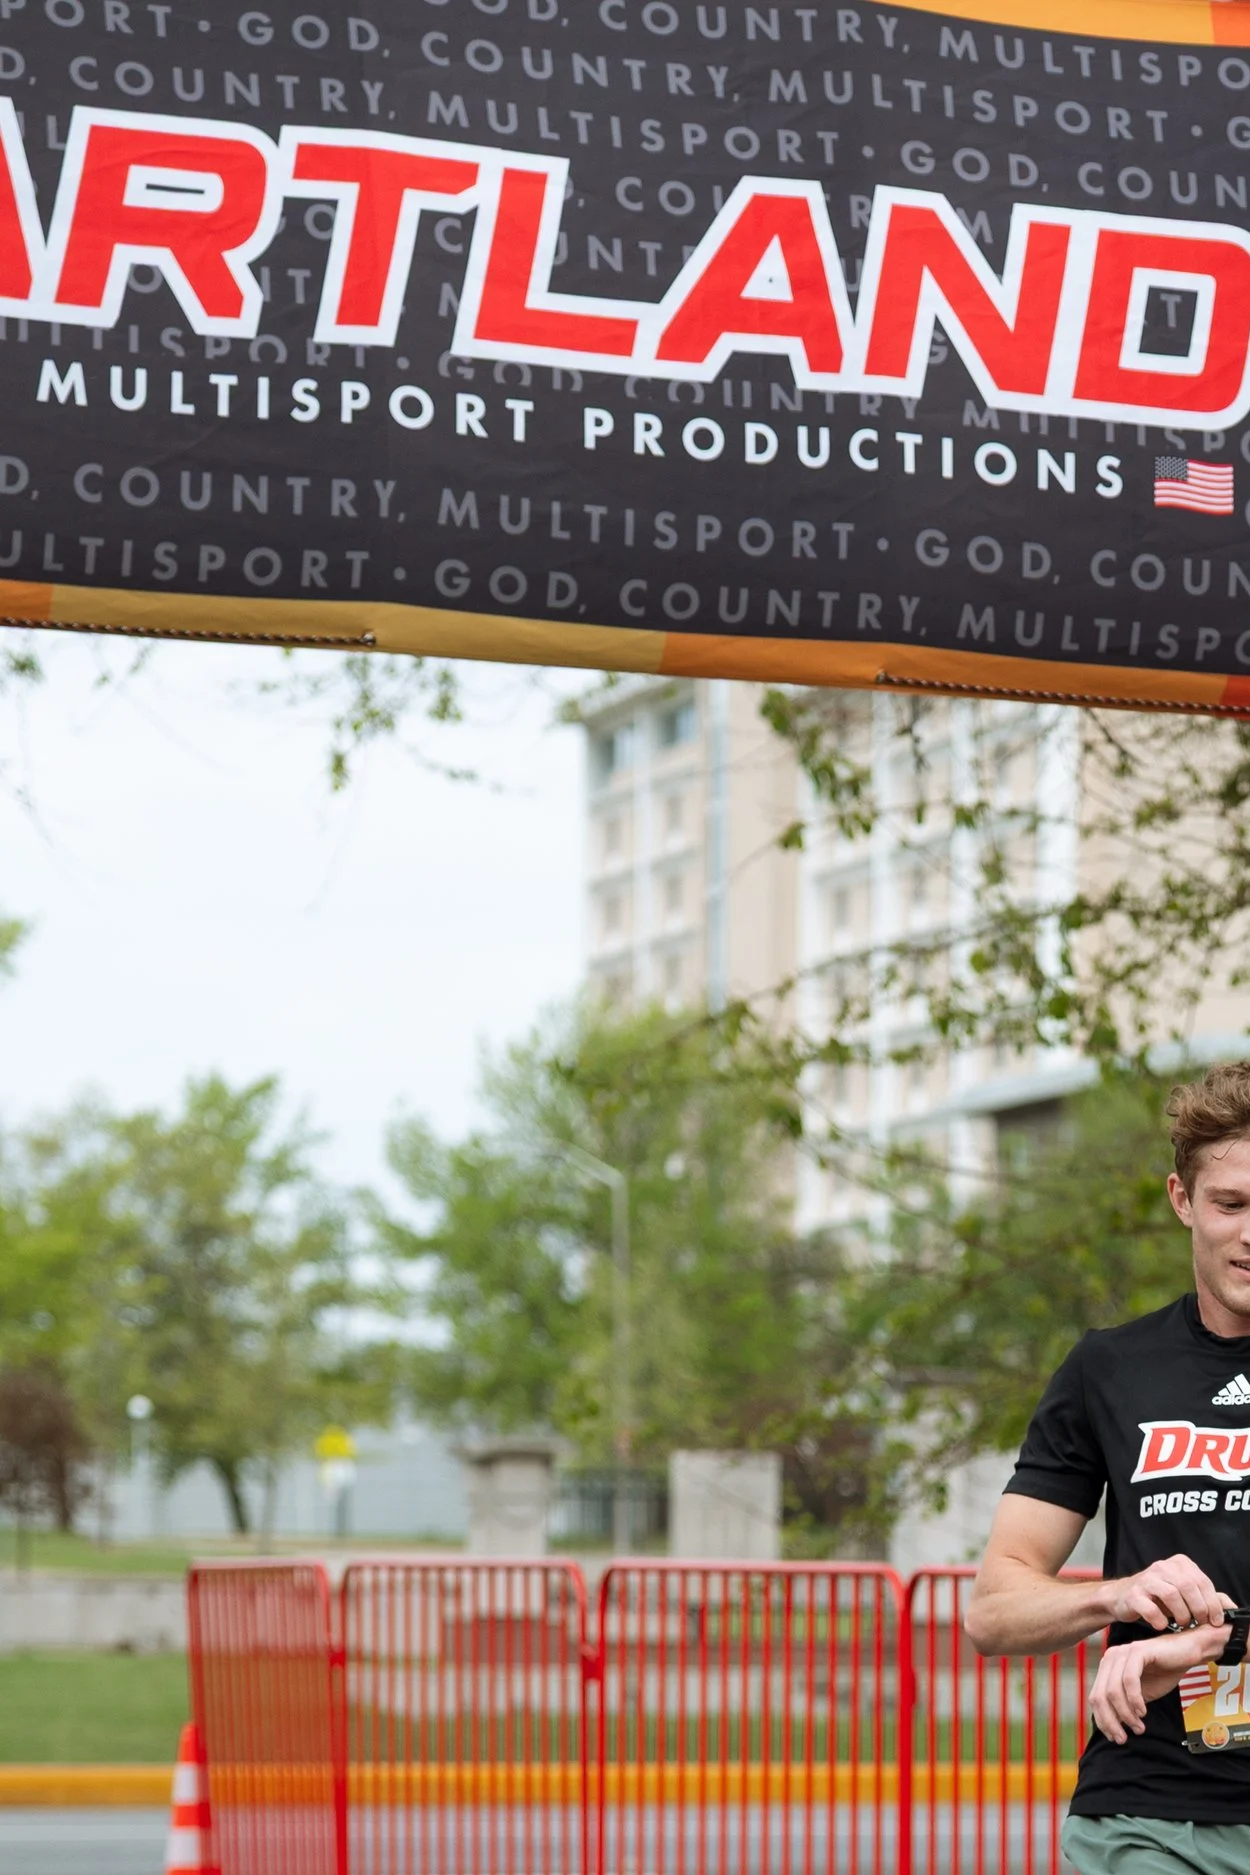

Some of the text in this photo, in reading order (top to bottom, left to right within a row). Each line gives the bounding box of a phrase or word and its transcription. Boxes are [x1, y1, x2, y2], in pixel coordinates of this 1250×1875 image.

[237, 11, 390, 58] GOD,
[420, 31, 740, 103] COUNTRY,
[768, 69, 1168, 142] MULTISPORT
[599, 0, 910, 53] COUNTRY,
[69, 56, 396, 120] COUNTRY,
[427, 91, 839, 164] MULTISPORT
[900, 140, 1049, 192] GOD,
[35, 358, 1124, 498] MULTISPORT PRODUCTIONS
[73, 463, 405, 523] COUNTRY,
[437, 487, 855, 560] MULTISPORT
[915, 528, 1061, 586] GOD,
[434, 559, 587, 614] GOD,
[618, 578, 927, 637] COUNTRY,
[1140, 1490, 1218, 1518] CROSS
